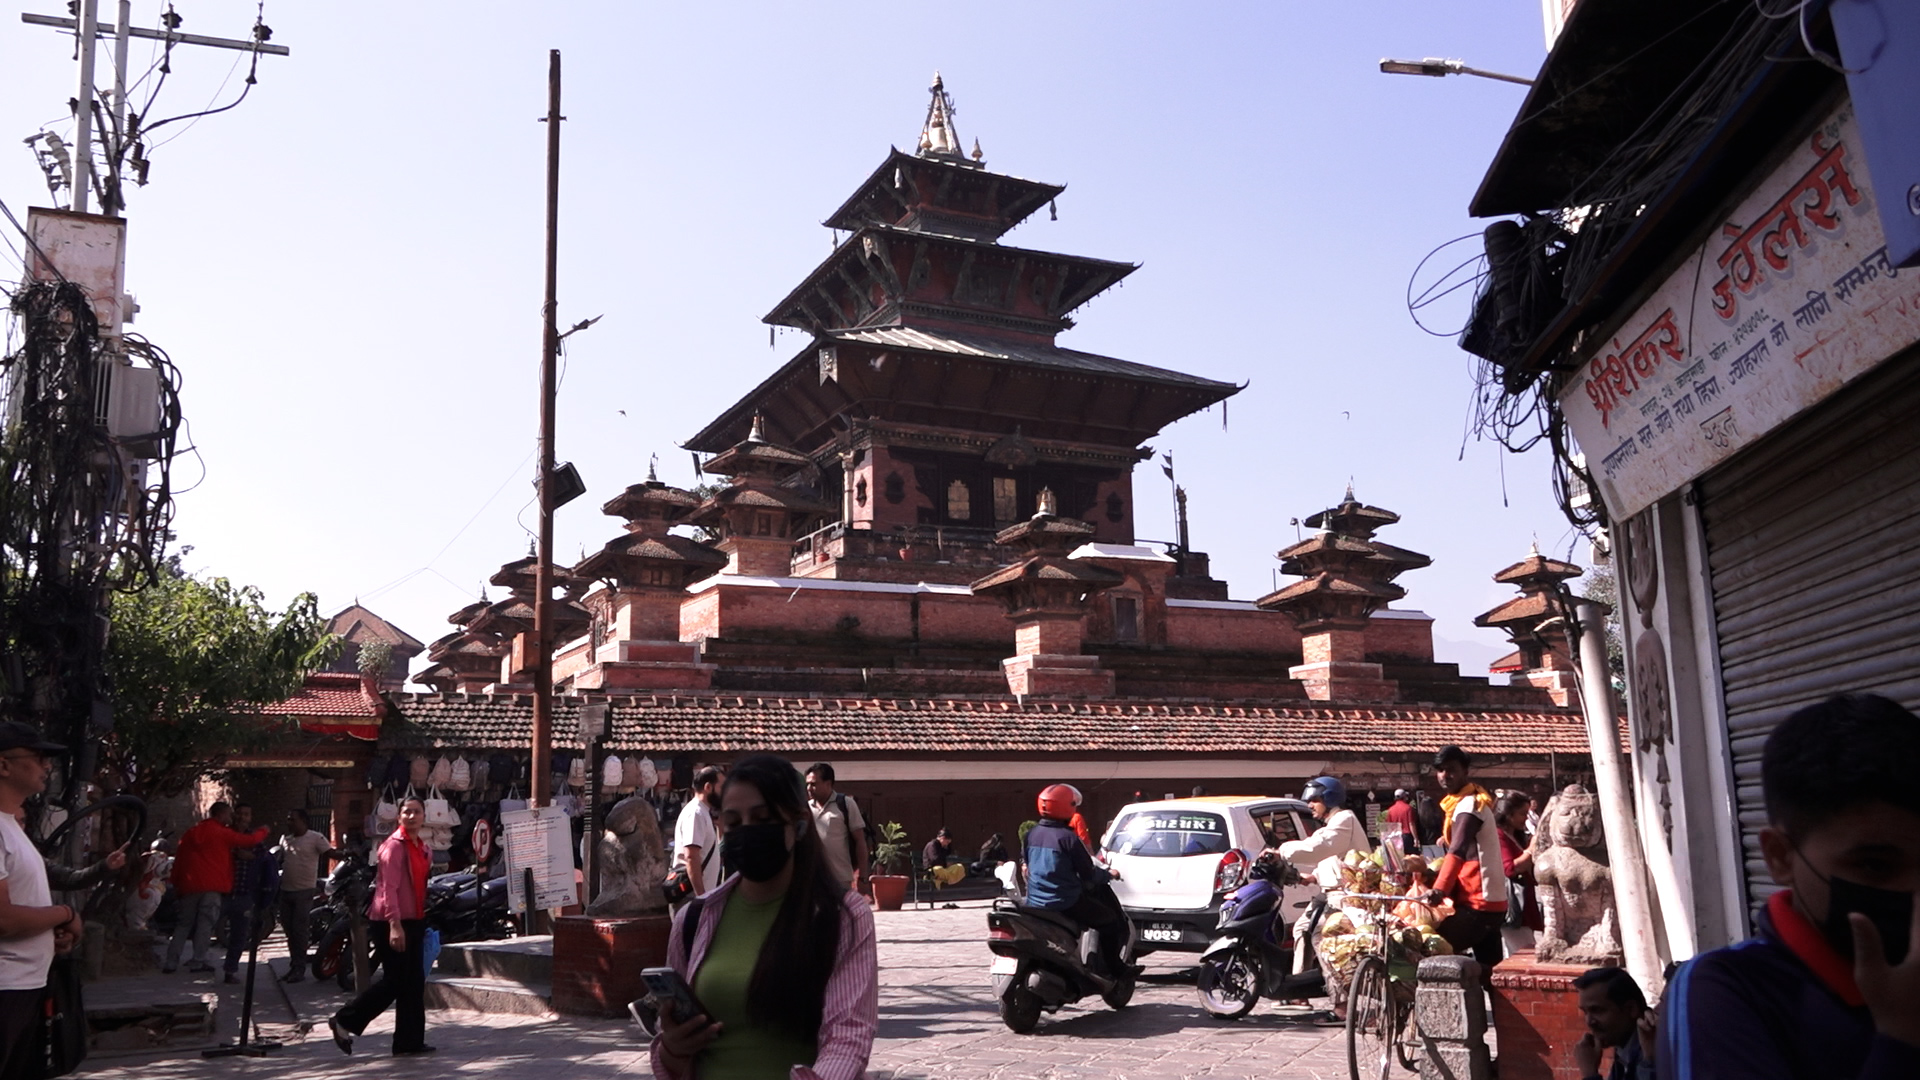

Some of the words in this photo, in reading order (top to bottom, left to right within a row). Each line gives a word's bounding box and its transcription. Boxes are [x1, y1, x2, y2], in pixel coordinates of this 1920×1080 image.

[1711, 131, 1863, 319] ज्वेलर्स
[1672, 393, 1695, 423] तथा
[1770, 318, 1790, 347] को
[1792, 290, 1832, 333] लागि
